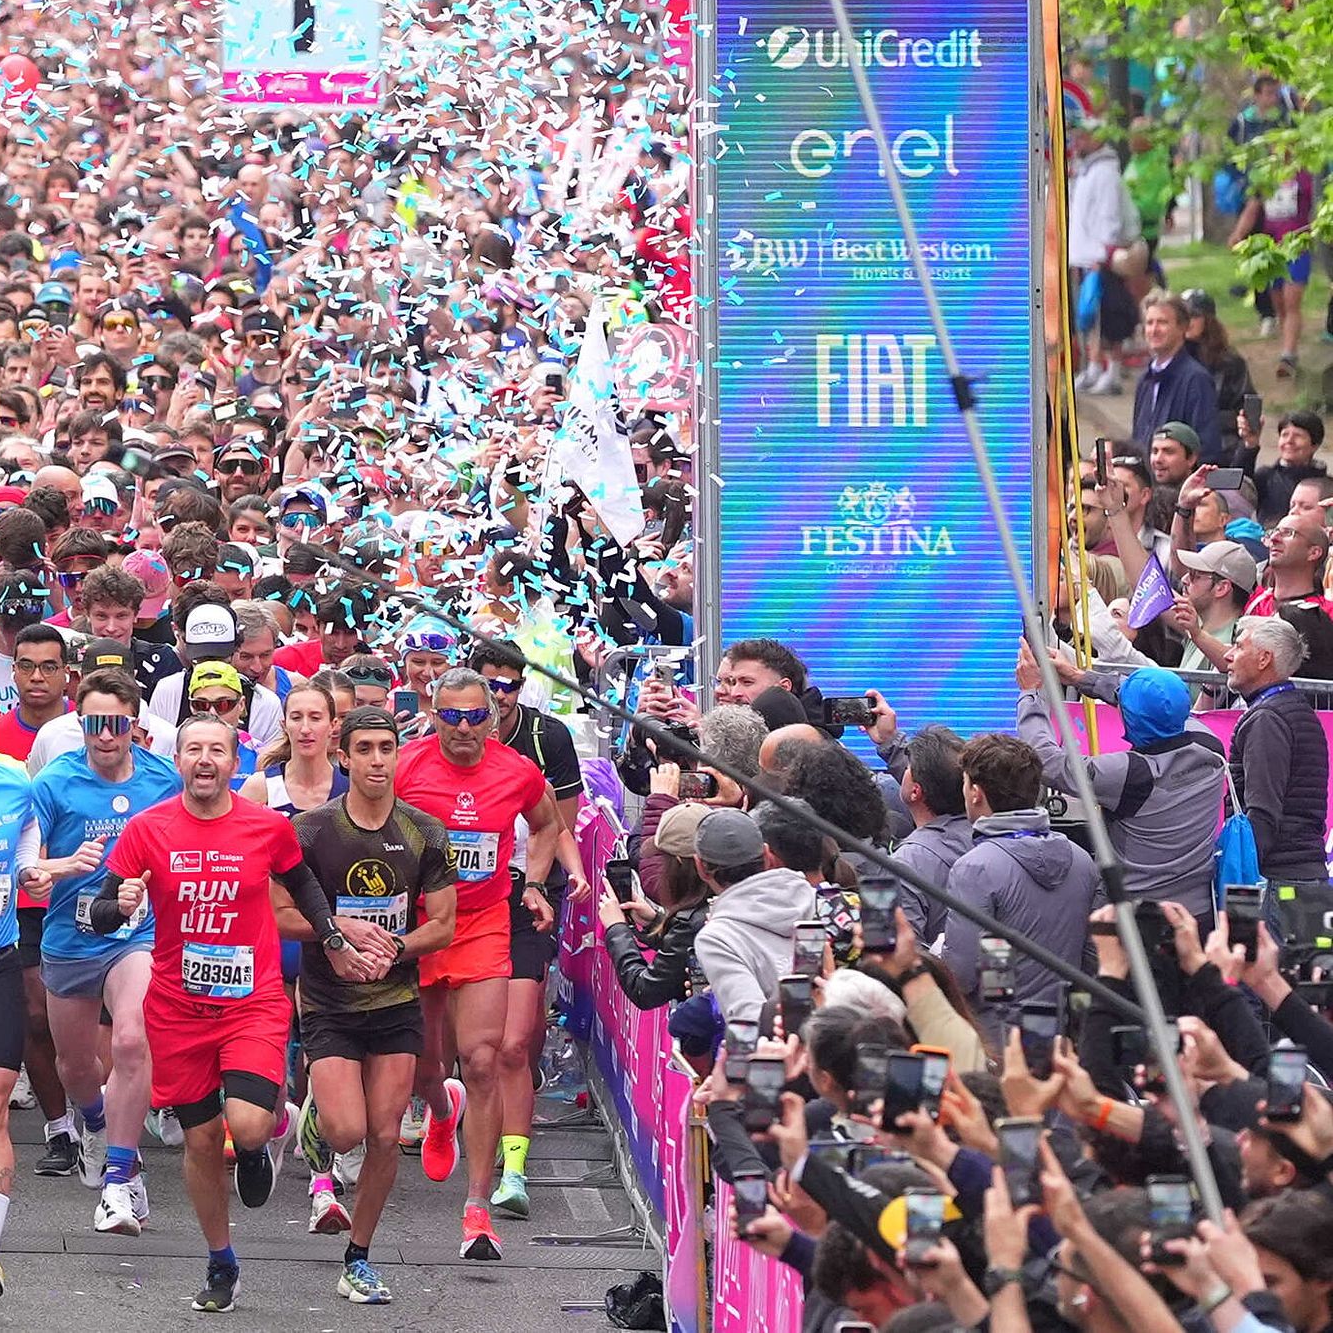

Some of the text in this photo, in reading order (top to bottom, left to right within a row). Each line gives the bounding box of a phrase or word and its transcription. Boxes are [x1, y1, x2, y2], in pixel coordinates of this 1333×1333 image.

[790, 114, 960, 179] enel
[753, 239, 808, 267] BW
[833, 237, 889, 262] Best
[923, 266, 972, 282] esorts
[815, 333, 936, 428] FIAT
[800, 526, 956, 555] FESTINA
[177, 880, 240, 902] RUN
[180, 911, 239, 934] LILT
[189, 961, 243, 985] 2839A
